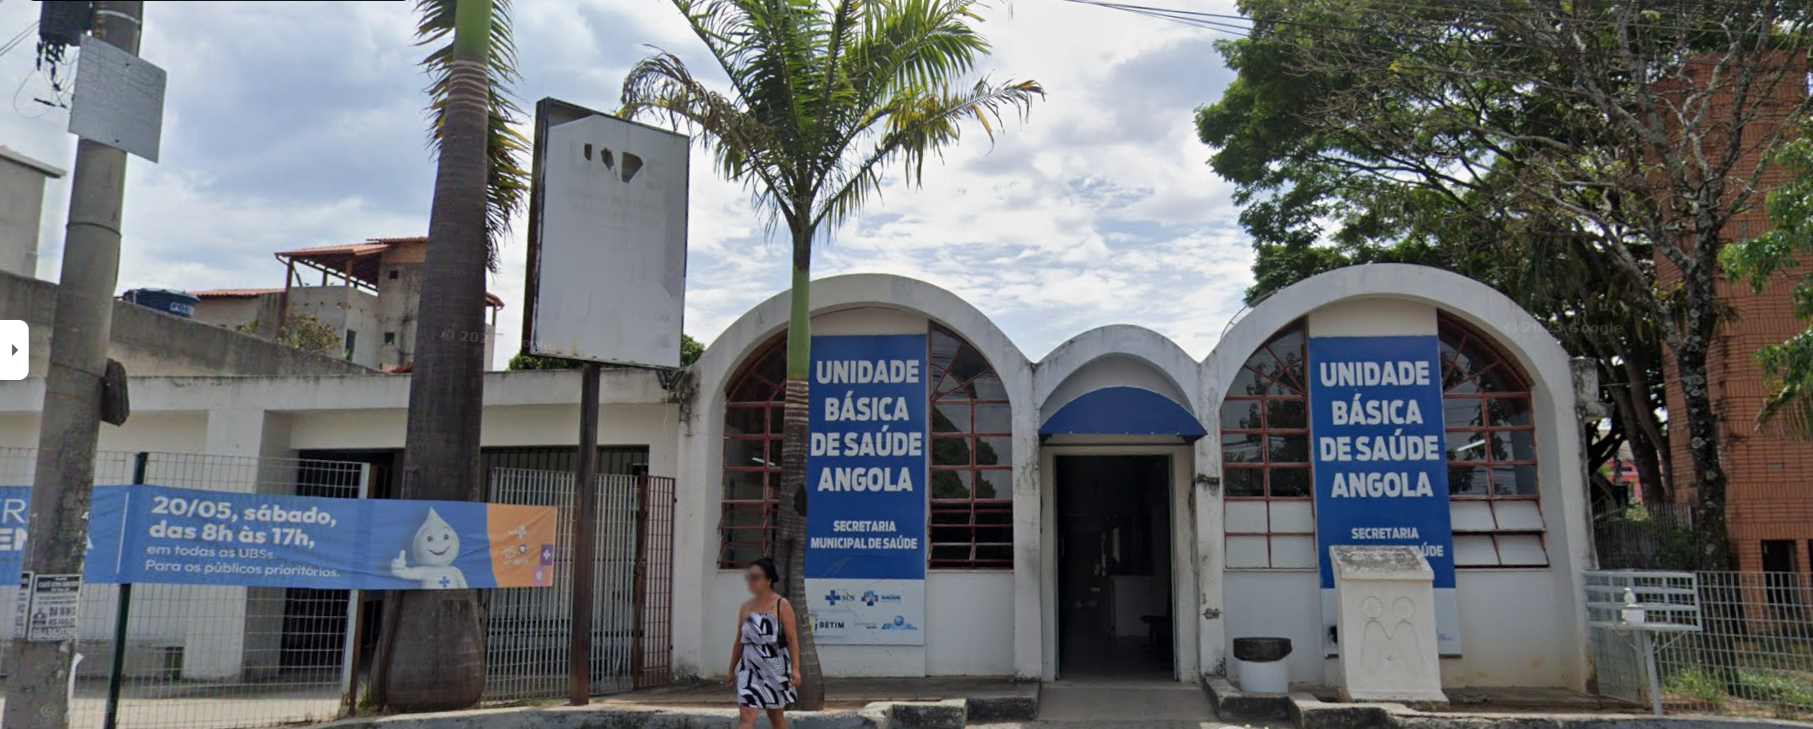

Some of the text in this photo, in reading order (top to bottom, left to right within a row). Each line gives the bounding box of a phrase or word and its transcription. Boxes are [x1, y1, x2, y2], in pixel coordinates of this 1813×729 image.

[816, 359, 919, 384] UNIDADE
[1320, 360, 1430, 387] UNIDADE
[824, 391, 910, 421] BÁSICA
[1332, 393, 1424, 425] BÁSICA
[810, 425, 922, 457] DE SAÚDE
[1319, 429, 1440, 461] DE SAÚDE
[817, 467, 913, 492] ANGOLA
[1331, 471, 1434, 498] ANGOLA
[151, 496, 337, 528] 20/05, sábado,
[149, 520, 315, 549] das 8h às 17h,
[833, 520, 896, 533] SECRETARIA
[1351, 527, 1419, 540] SECRETARIA
[146, 546, 171, 555] em
[174, 545, 216, 558] todas
[218, 549, 235, 558] as
[810, 533, 918, 550] MUNICIPAL DE SAÚDE
[1421, 541, 1444, 557] ÚDE
[145, 559, 340, 578] Para os públicos prioritários.
[819, 621, 845, 629] BETIM
